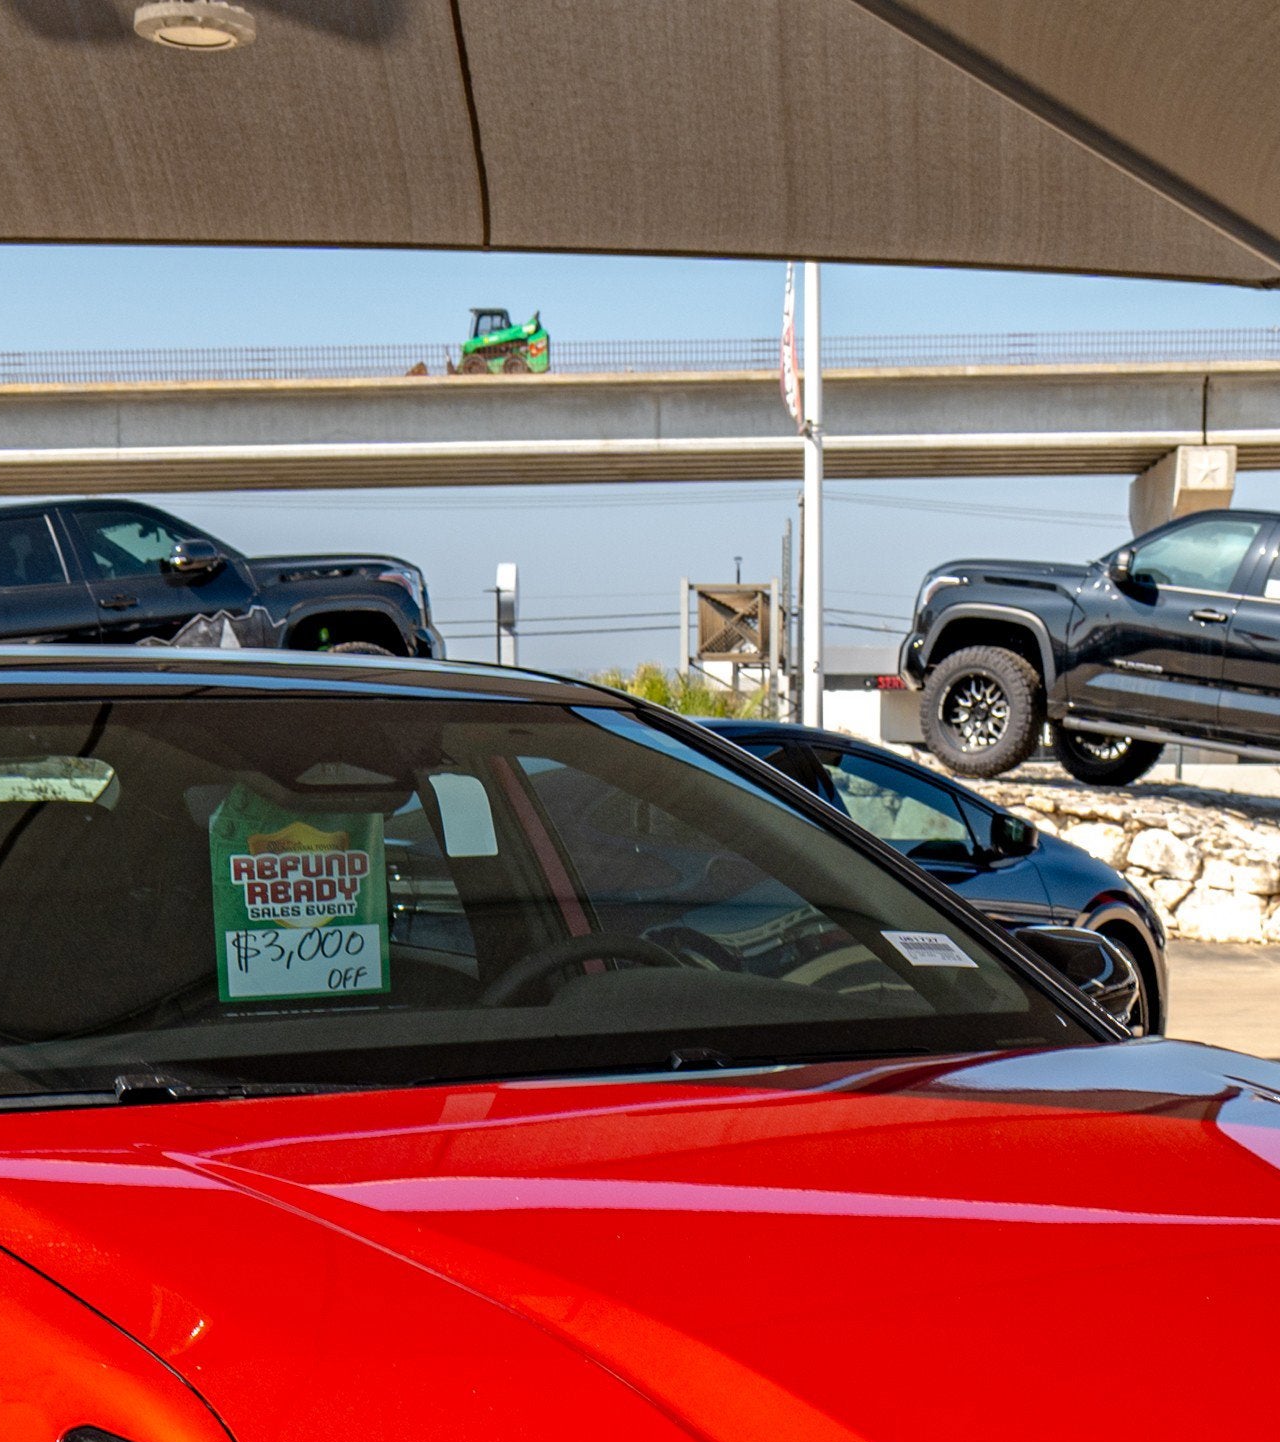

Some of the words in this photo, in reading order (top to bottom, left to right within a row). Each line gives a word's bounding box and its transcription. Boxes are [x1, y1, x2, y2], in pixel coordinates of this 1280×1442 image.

[232, 852, 369, 882] REFUND
[247, 877, 358, 905] READY
[250, 905, 301, 919] SALES
[306, 902, 356, 917] EVENT
[232, 927, 364, 974] $3,000
[328, 966, 368, 989] OFF
